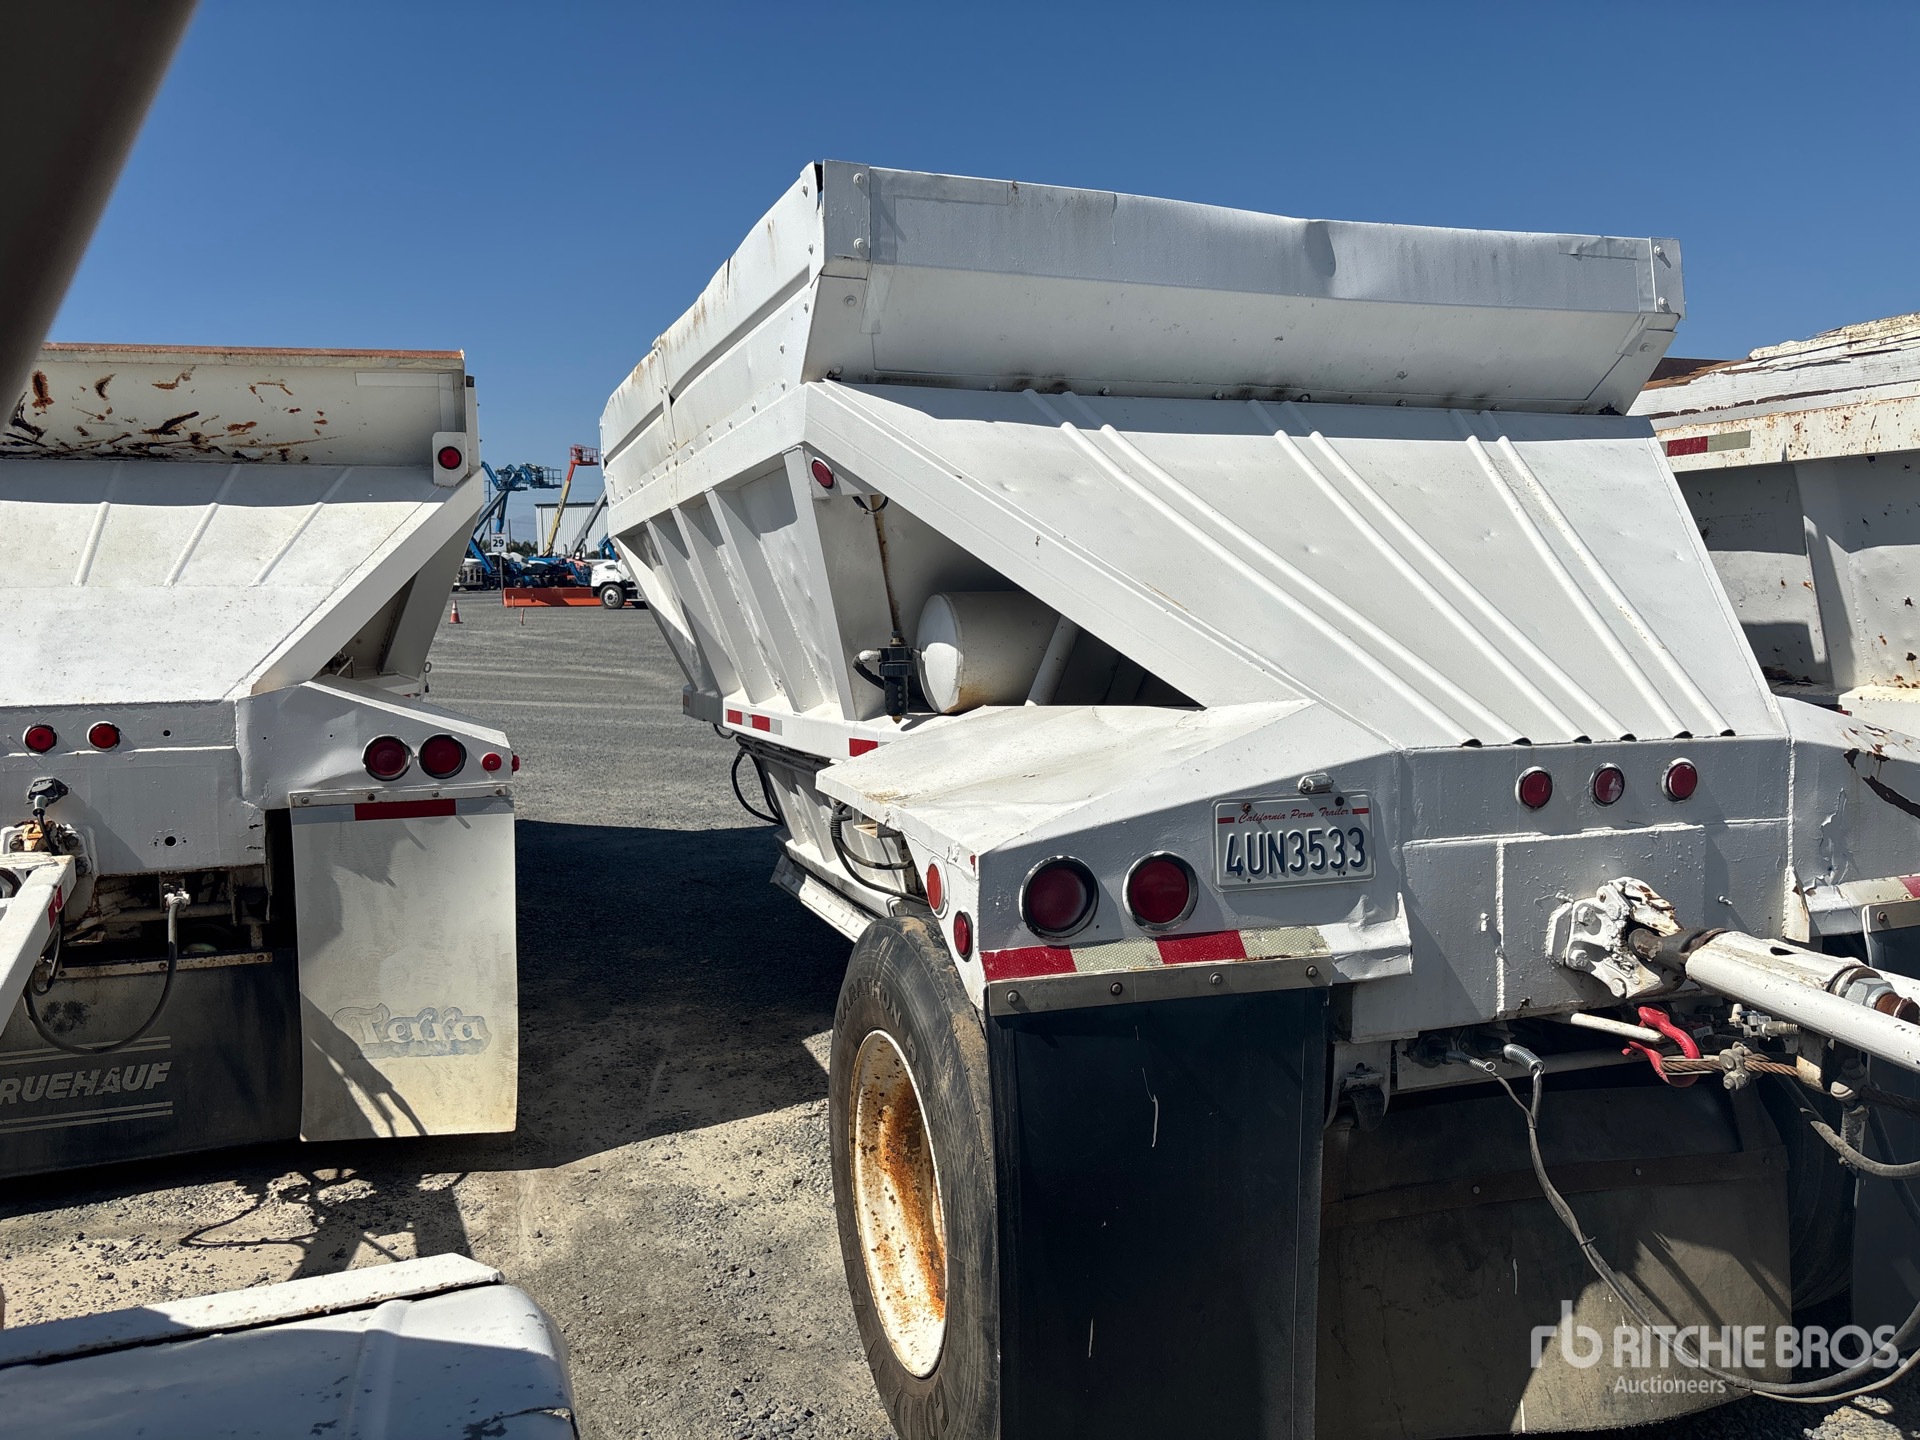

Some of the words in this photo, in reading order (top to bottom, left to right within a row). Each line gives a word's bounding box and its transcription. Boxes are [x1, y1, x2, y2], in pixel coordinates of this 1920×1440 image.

[492, 539, 505, 548] 29
[1238, 811, 1286, 824] California
[1290, 808, 1315, 820] Perm
[1319, 806, 1350, 817] Trailer
[1225, 826, 1367, 876] 4UN3533
